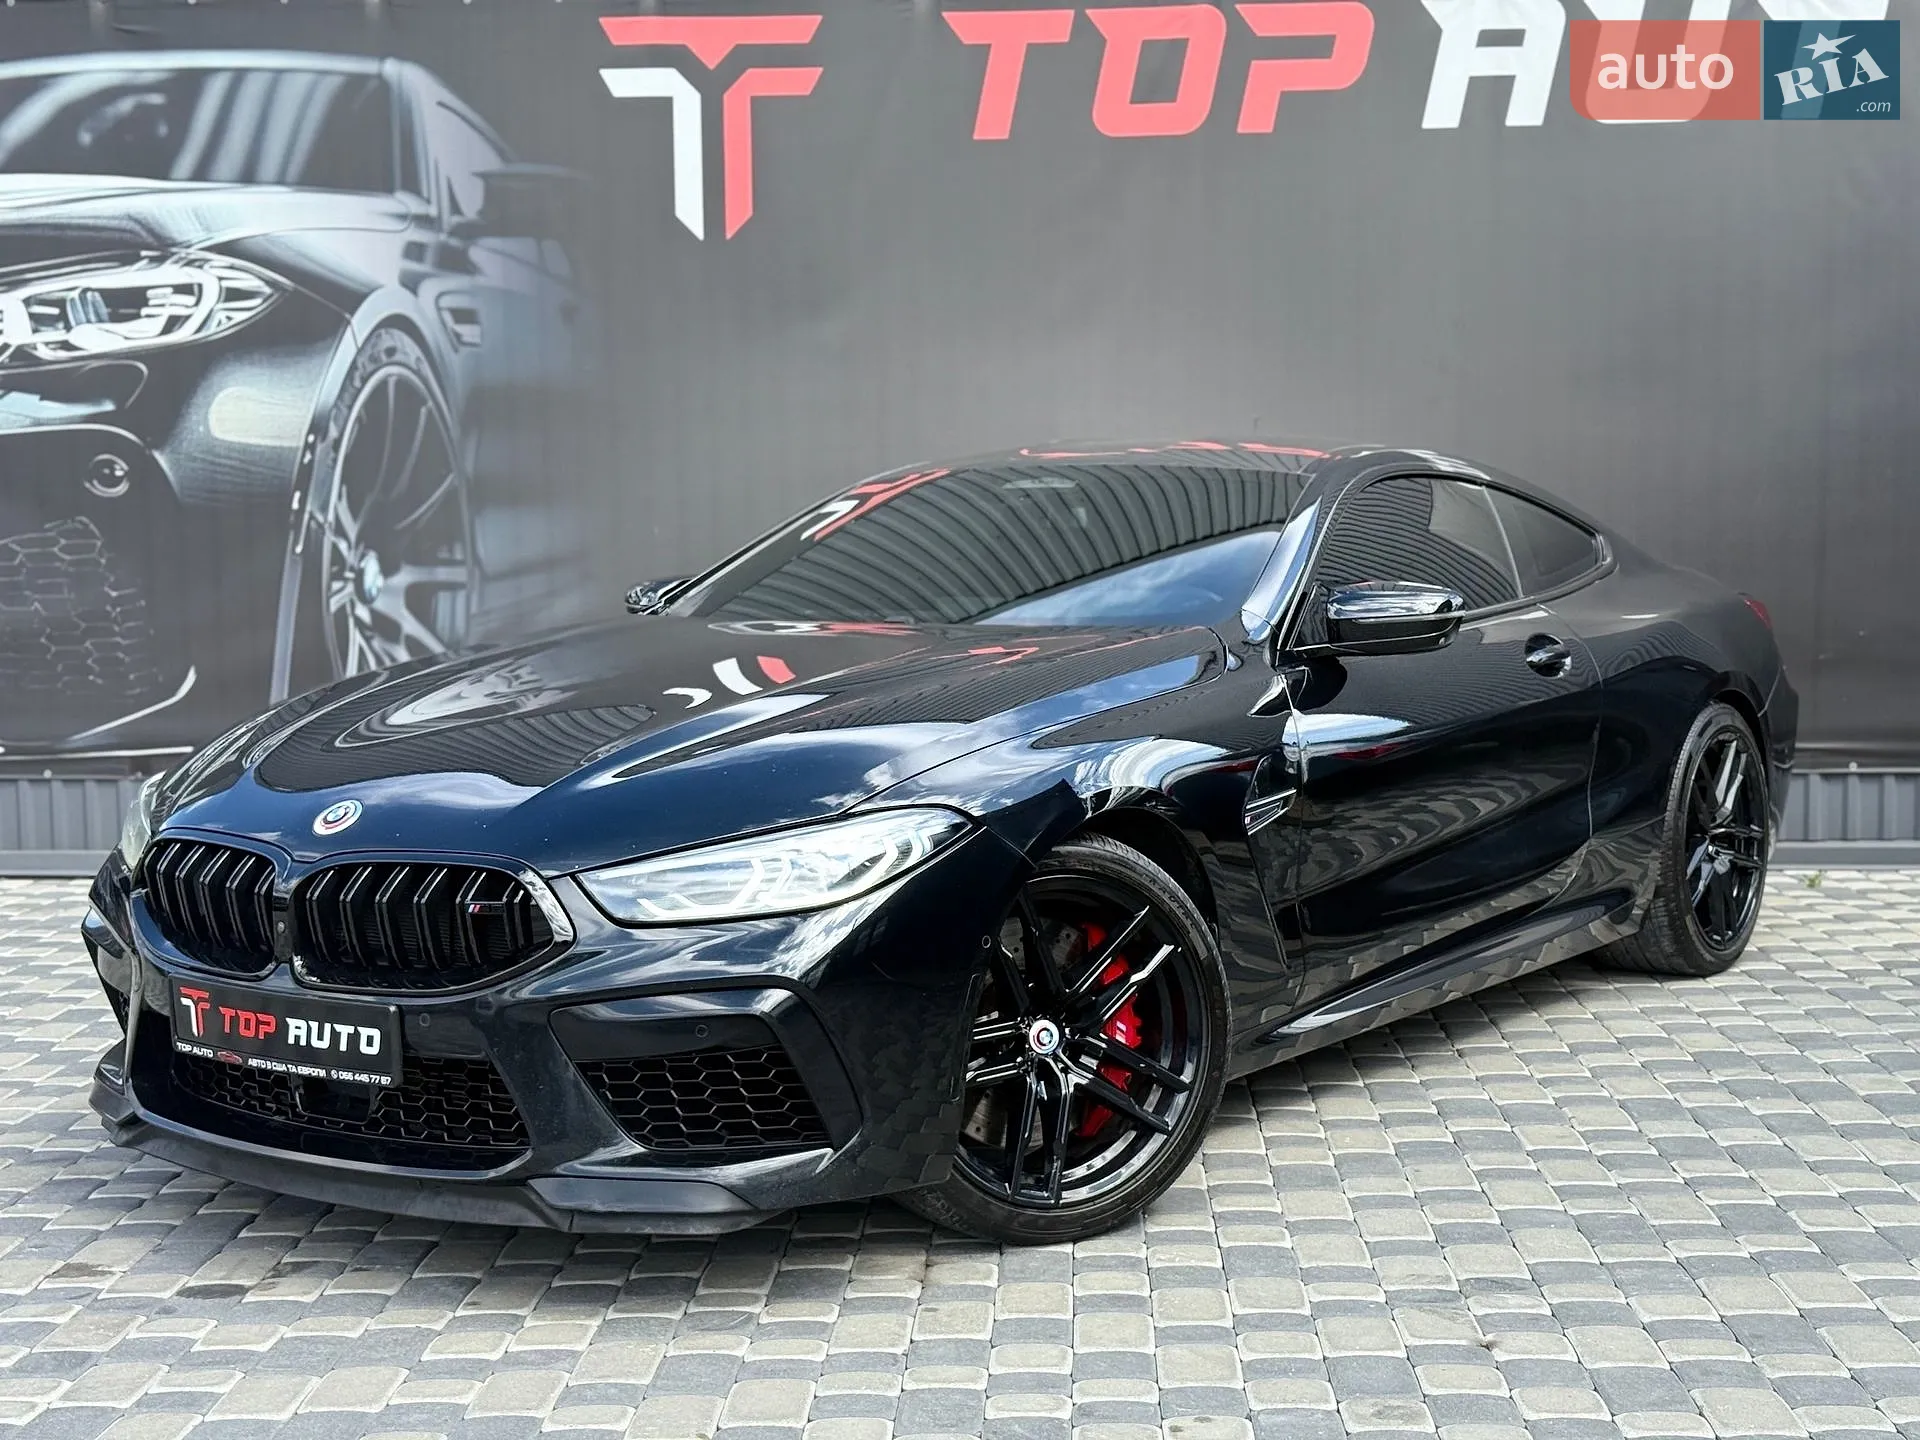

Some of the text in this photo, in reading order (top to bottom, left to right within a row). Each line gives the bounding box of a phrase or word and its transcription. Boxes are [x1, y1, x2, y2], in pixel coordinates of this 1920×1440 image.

[946, 1, 1374, 140] TOP
[219, 1006, 381, 1055] TOP AUTO
[176, 1041, 214, 1058] TOP AUTO
[370, 1075, 380, 1084] 77
